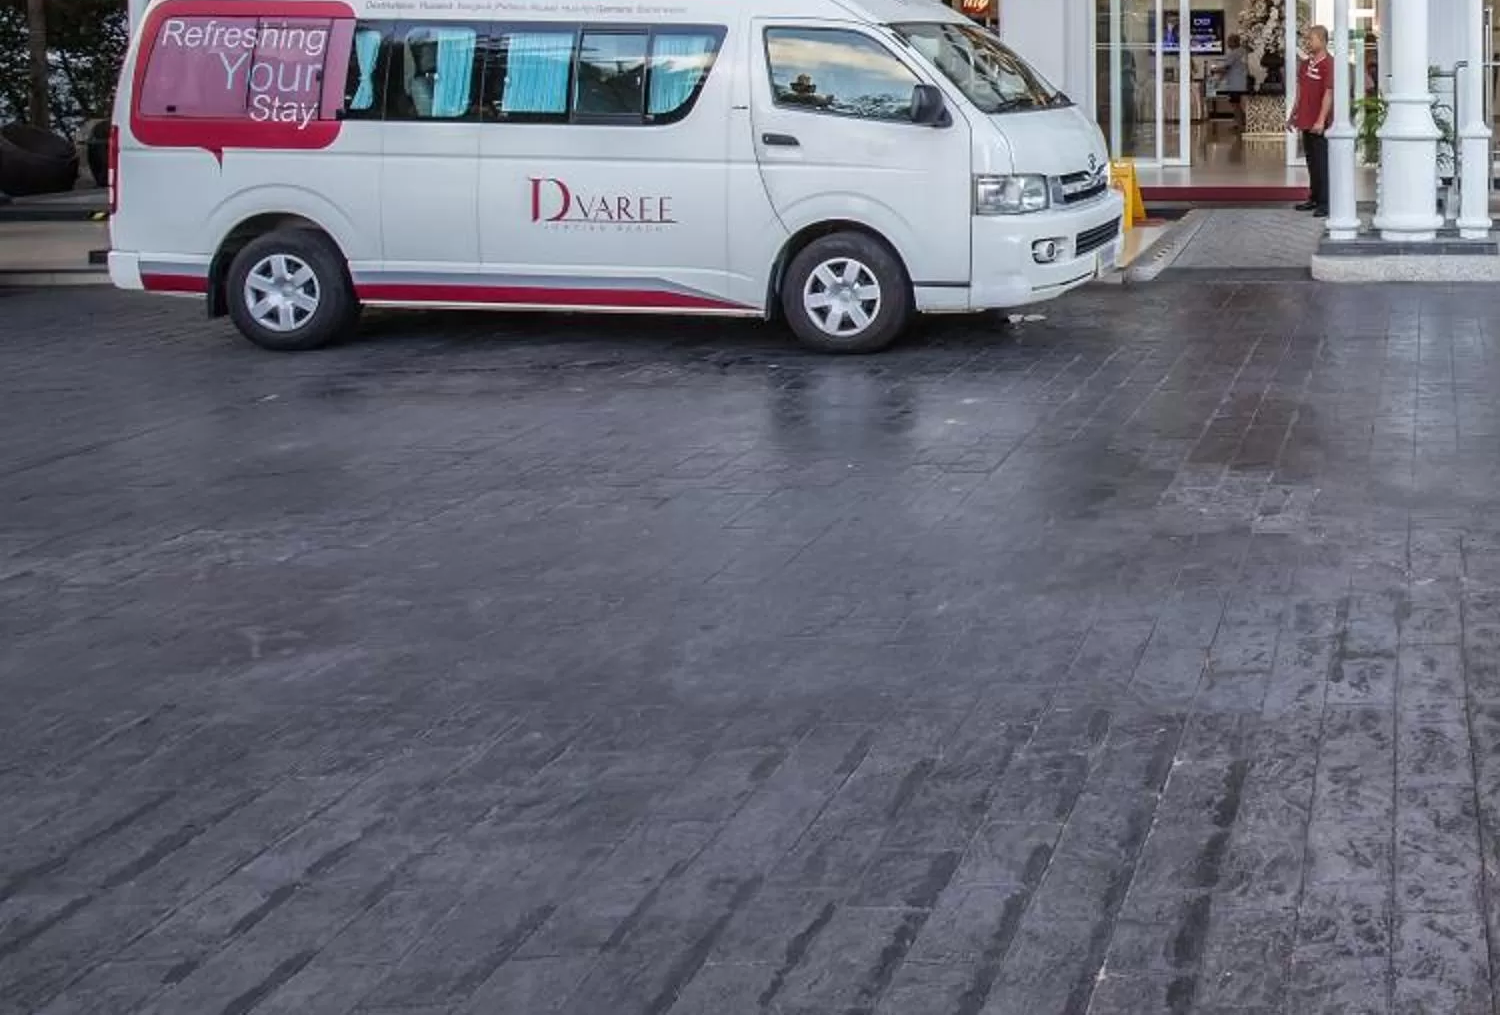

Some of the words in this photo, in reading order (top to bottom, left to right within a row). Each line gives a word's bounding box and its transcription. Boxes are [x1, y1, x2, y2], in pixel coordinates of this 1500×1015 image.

[161, 20, 327, 56] Refreshing
[219, 51, 323, 92] Your
[250, 94, 319, 130] Stay
[527, 177, 674, 223] DVAREE
